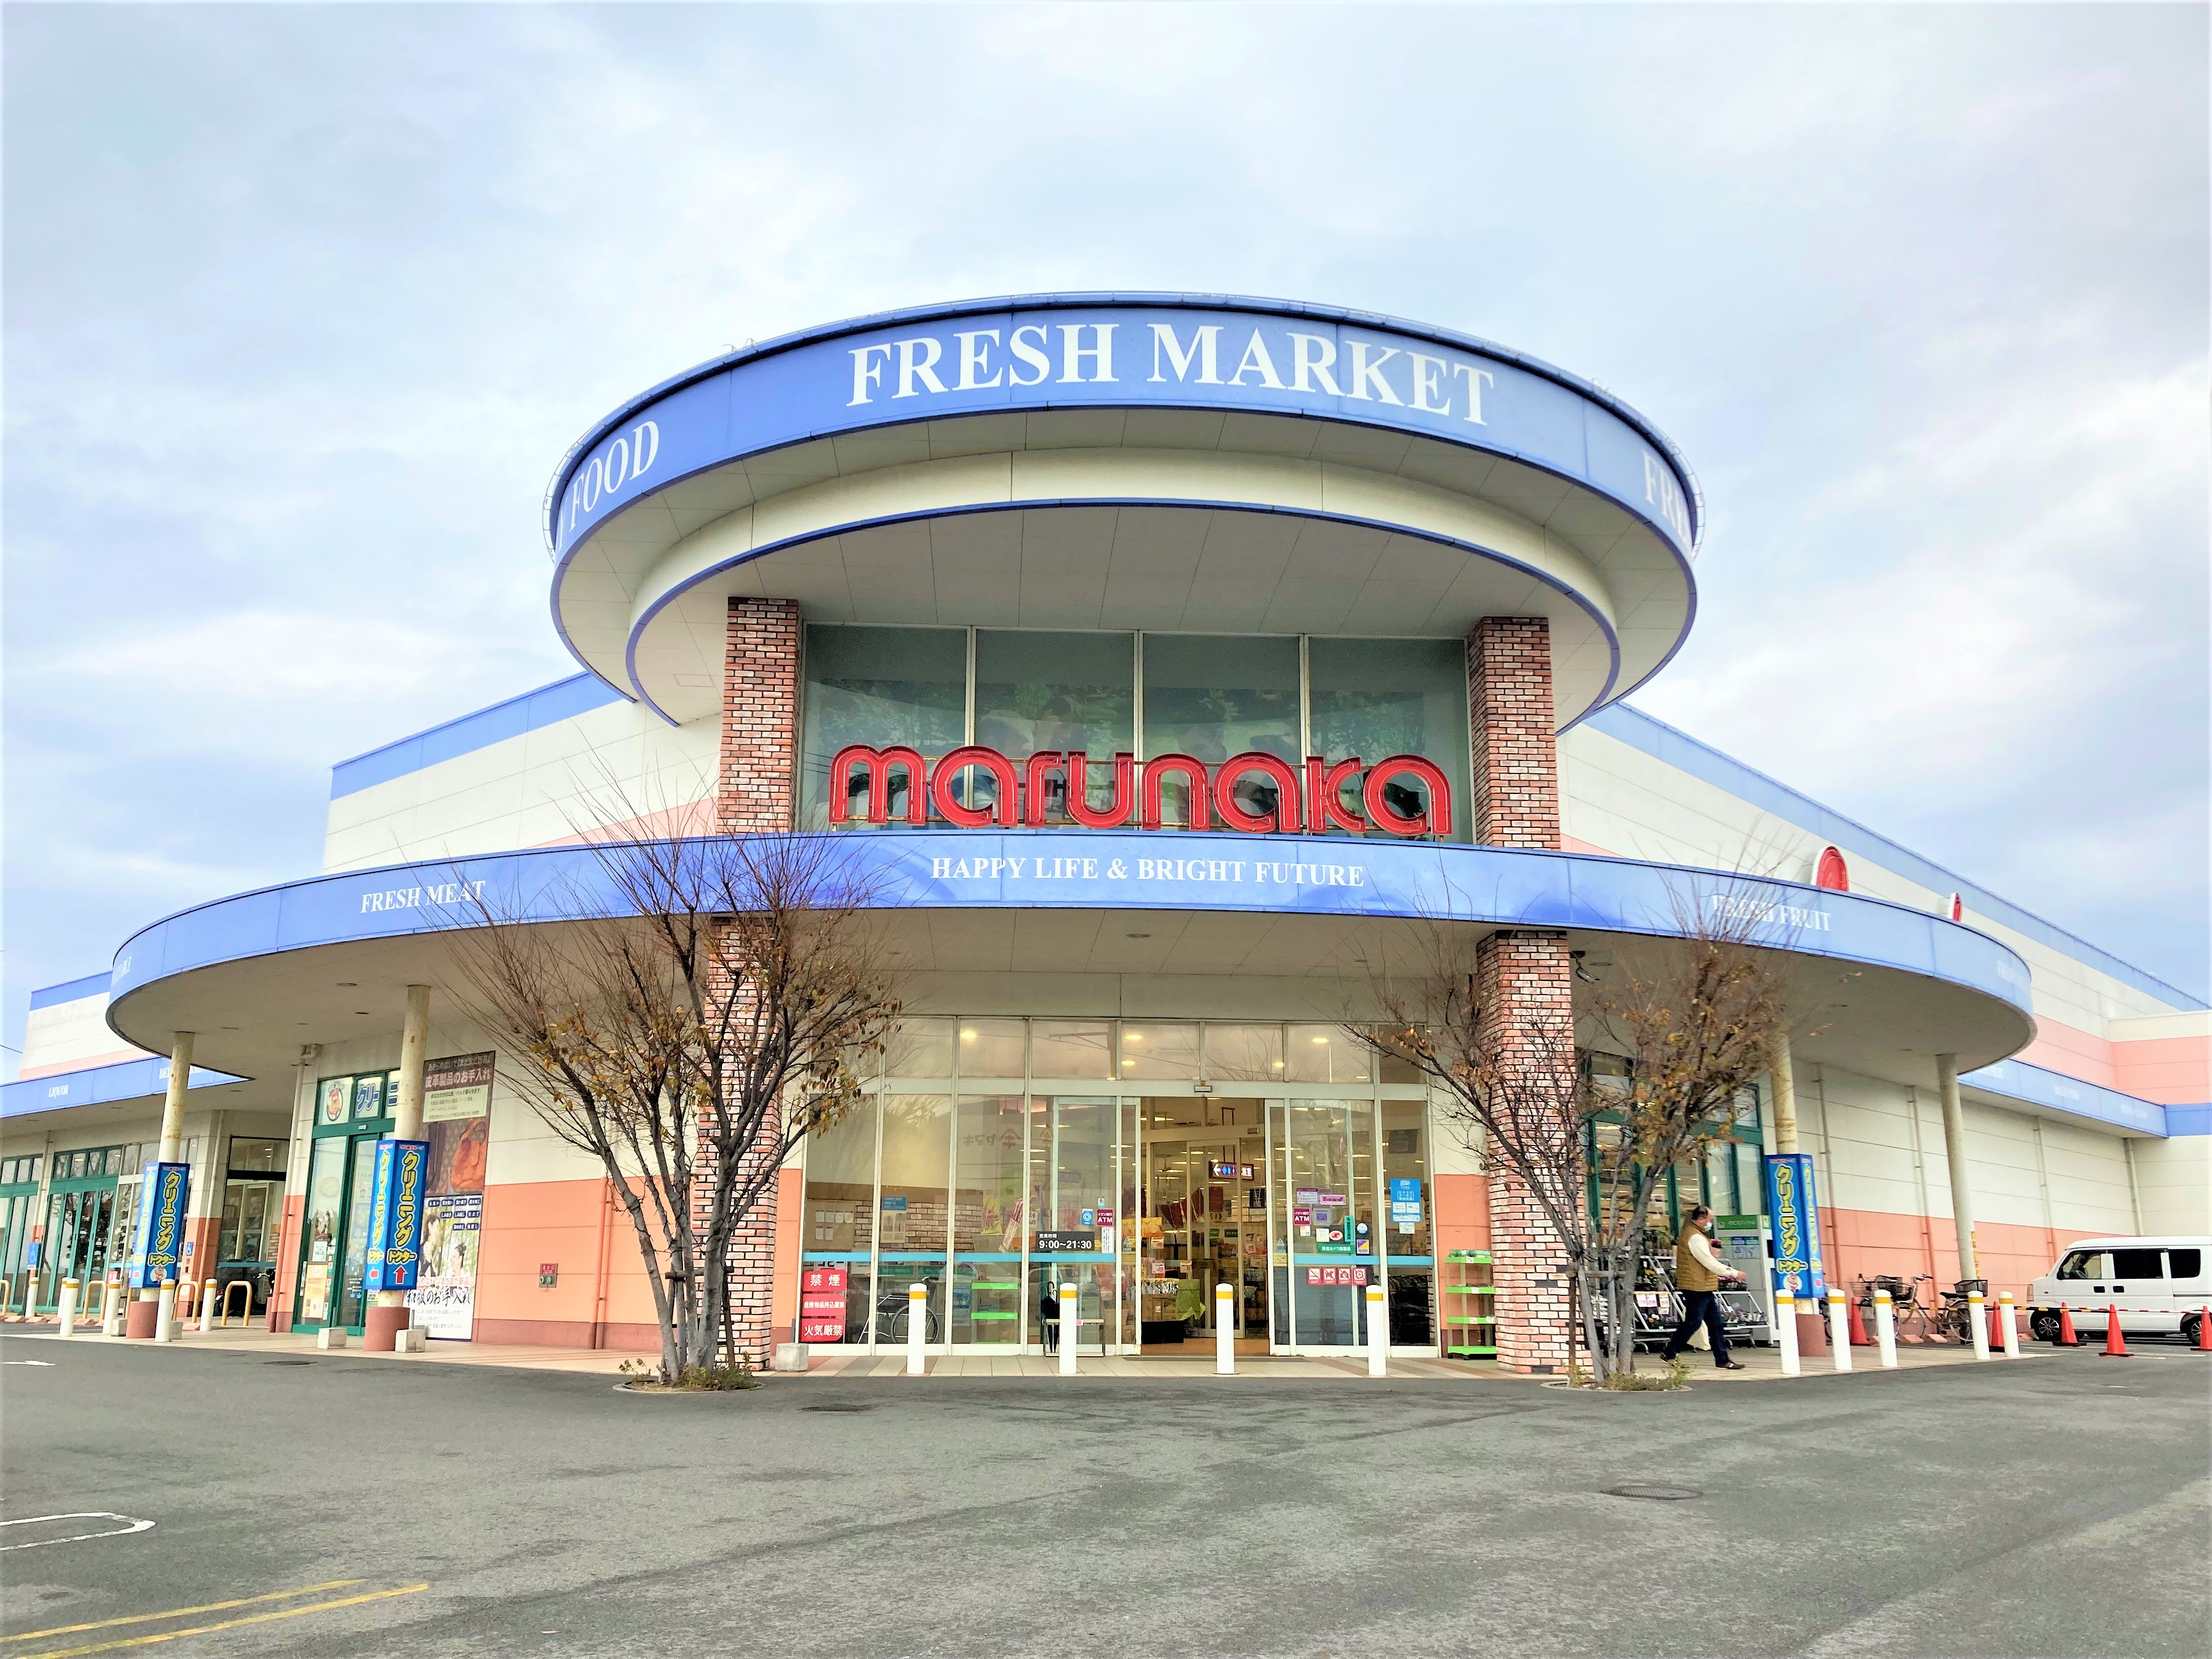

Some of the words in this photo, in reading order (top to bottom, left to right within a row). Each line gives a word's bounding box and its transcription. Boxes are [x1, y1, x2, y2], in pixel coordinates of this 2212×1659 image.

[847, 323, 1120, 407] FRESH
[1147, 323, 1494, 426] MARKET
[569, 421, 659, 533] FOOD
[829, 744, 1452, 835] marunaka
[931, 857, 1026, 880] HAPPY
[1034, 858, 1097, 880] LIFE
[1107, 859, 1128, 880] &
[1137, 859, 1246, 883] BRIGHT
[1255, 861, 1364, 888] FUTURE
[360, 887, 421, 913] FRESH
[425, 881, 486, 905] MEAT
[1779, 905, 1831, 932] FRUIT
[48, 1085, 69, 1099] LIQUOR
[157, 1172, 180, 1251] クリーニング
[374, 1152, 390, 1246] クリーニング
[396, 1152, 418, 1246] クリーニング
[1777, 1165, 1798, 1256] クリーニング
[149, 1254, 174, 1265] ドクター
[388, 1250, 415, 1262] ドクター
[1778, 1260, 1807, 1272] ドクター
[810, 1273, 840, 1286] 禁煙
[804, 1324, 843, 1336] 火気厳禁
